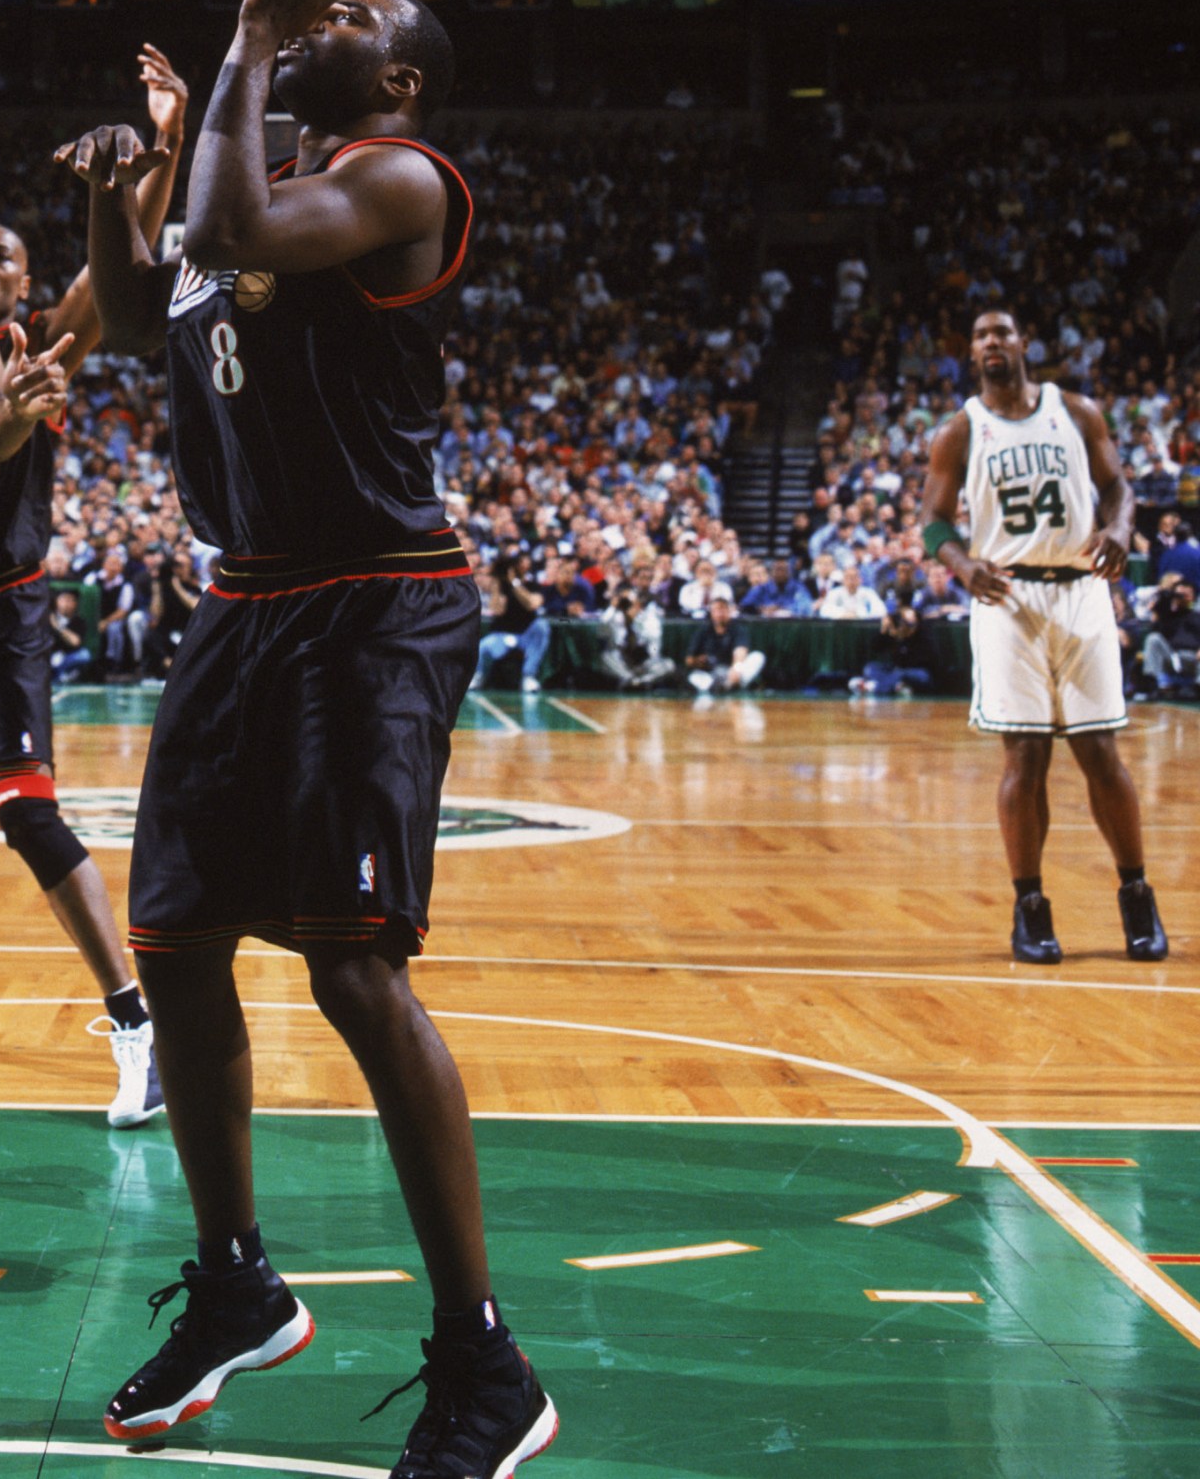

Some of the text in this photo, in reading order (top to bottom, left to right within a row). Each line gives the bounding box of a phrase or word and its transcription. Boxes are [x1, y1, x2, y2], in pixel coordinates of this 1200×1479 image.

[209, 319, 245, 397] 8
[987, 443, 1069, 487] CELTICS
[997, 480, 1066, 536] 54
